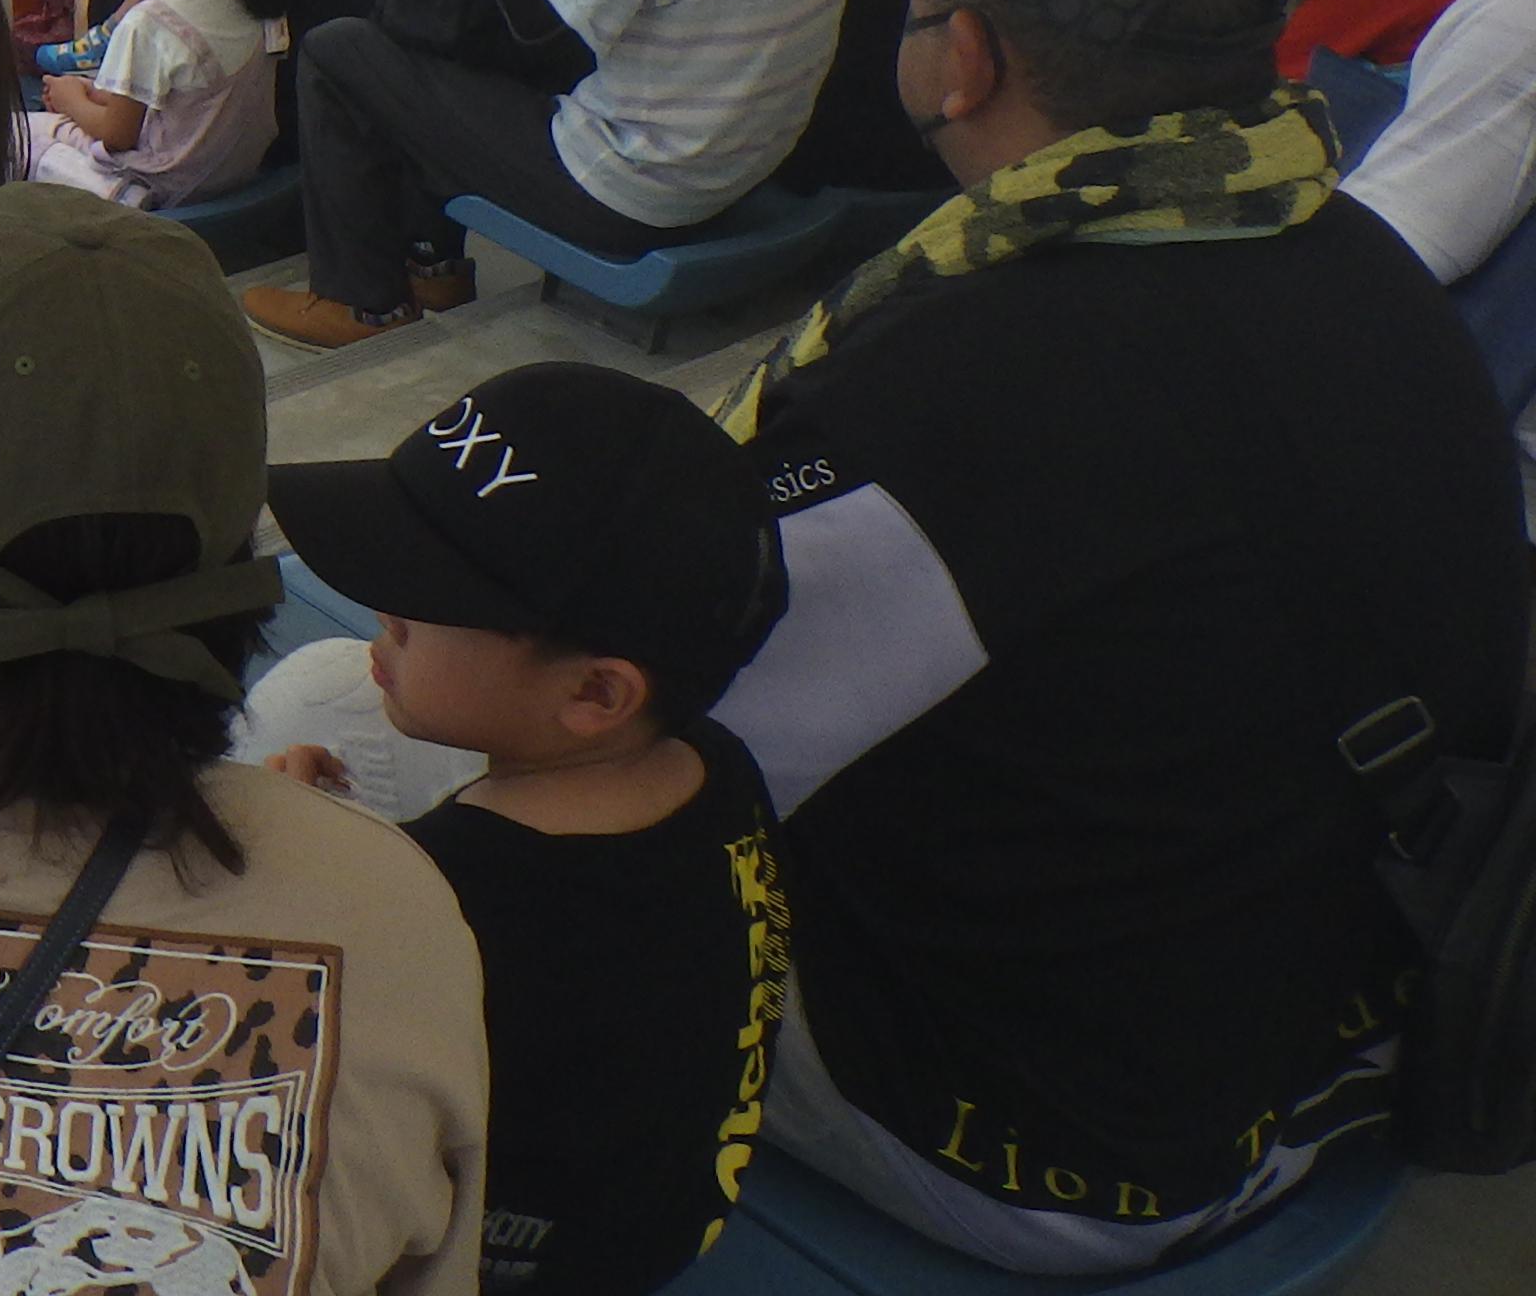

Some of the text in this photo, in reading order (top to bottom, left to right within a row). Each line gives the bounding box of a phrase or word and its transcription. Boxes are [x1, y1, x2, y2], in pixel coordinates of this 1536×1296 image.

[767, 458, 836, 502] sics
[34, 971, 237, 1072] omfort
[936, 1096, 1161, 1217] Lion
